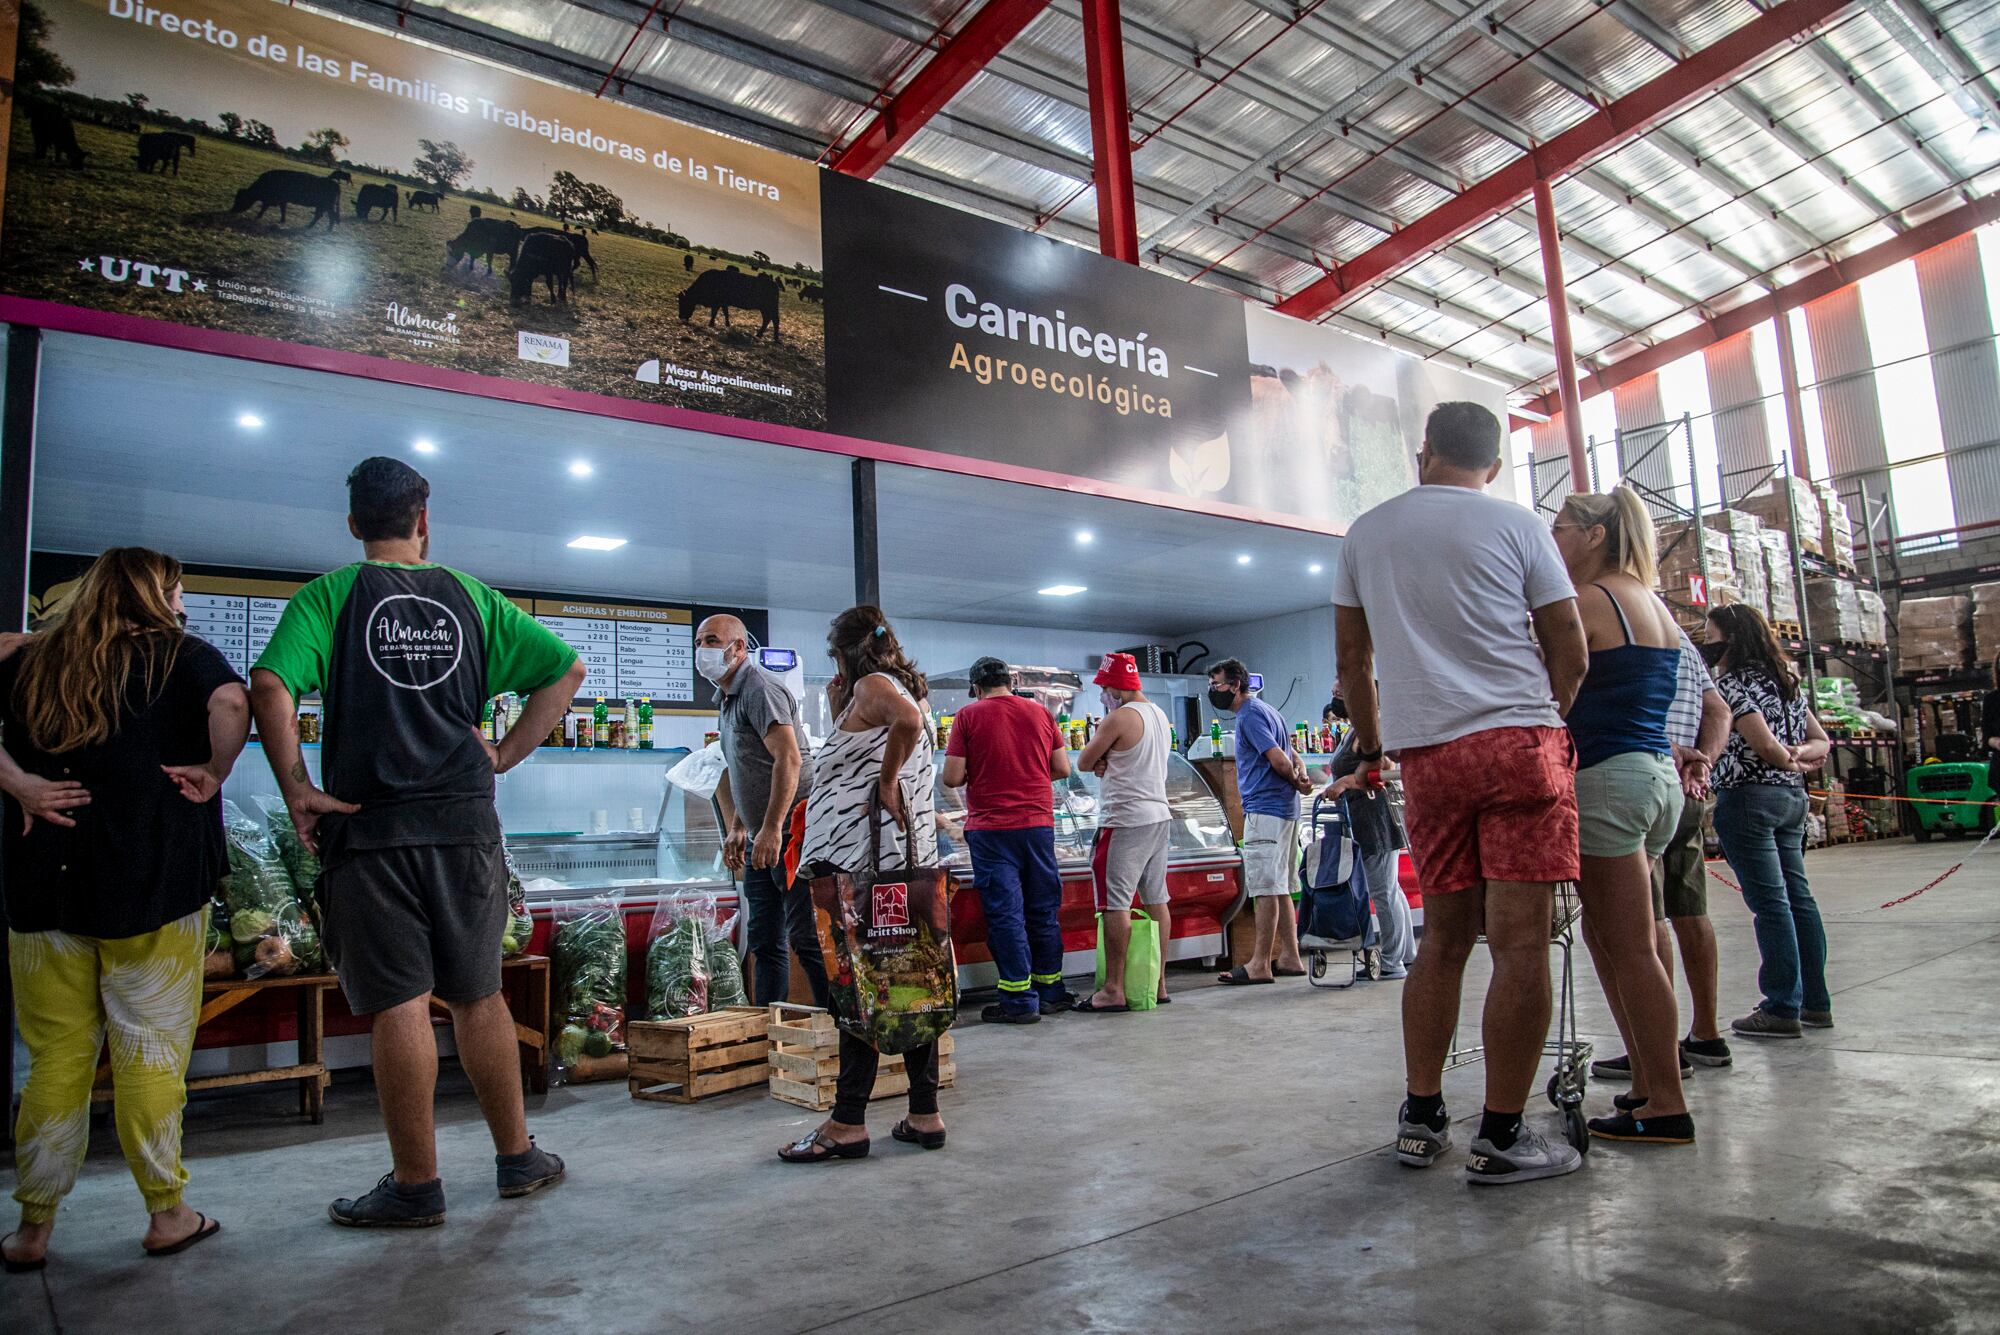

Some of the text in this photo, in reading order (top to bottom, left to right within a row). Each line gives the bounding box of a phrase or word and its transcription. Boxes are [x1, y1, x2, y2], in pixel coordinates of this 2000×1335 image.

[109, 0, 780, 201] Directo de las Familias Trabajadoras de la Tierra
[100, 255, 189, 293] UTT
[217, 279, 247, 291] Unión
[250, 284, 263, 294] de
[266, 287, 328, 307] Trabajadores
[217, 290, 337, 319] Trabajadoras de la Tierra
[397, 328, 420, 337] RAMOS
[421, 332, 461, 344] GENERALES
[945, 284, 1169, 378] Carnicería
[413, 338, 434, 348] UTT
[524, 335, 563, 351] RENAMA
[665, 363, 793, 396] Mesa Agroalimentaria
[665, 375, 724, 396] Argentina
[949, 342, 1172, 418] Agroecológica
[1690, 577, 1706, 603] K
[226, 600, 243, 608] 830
[253, 601, 277, 609] Colita
[253, 614, 275, 622] Lomo
[562, 606, 668, 619] ACHURAS Y EMBUTIDOS
[225, 625, 243, 633] 780
[620, 624, 652, 632] Mondongo
[224, 638, 243, 646] 740
[620, 657, 643, 665] Lengua
[867, 926, 918, 938] Britt Shop
[1398, 1138, 1427, 1154] NIKE
